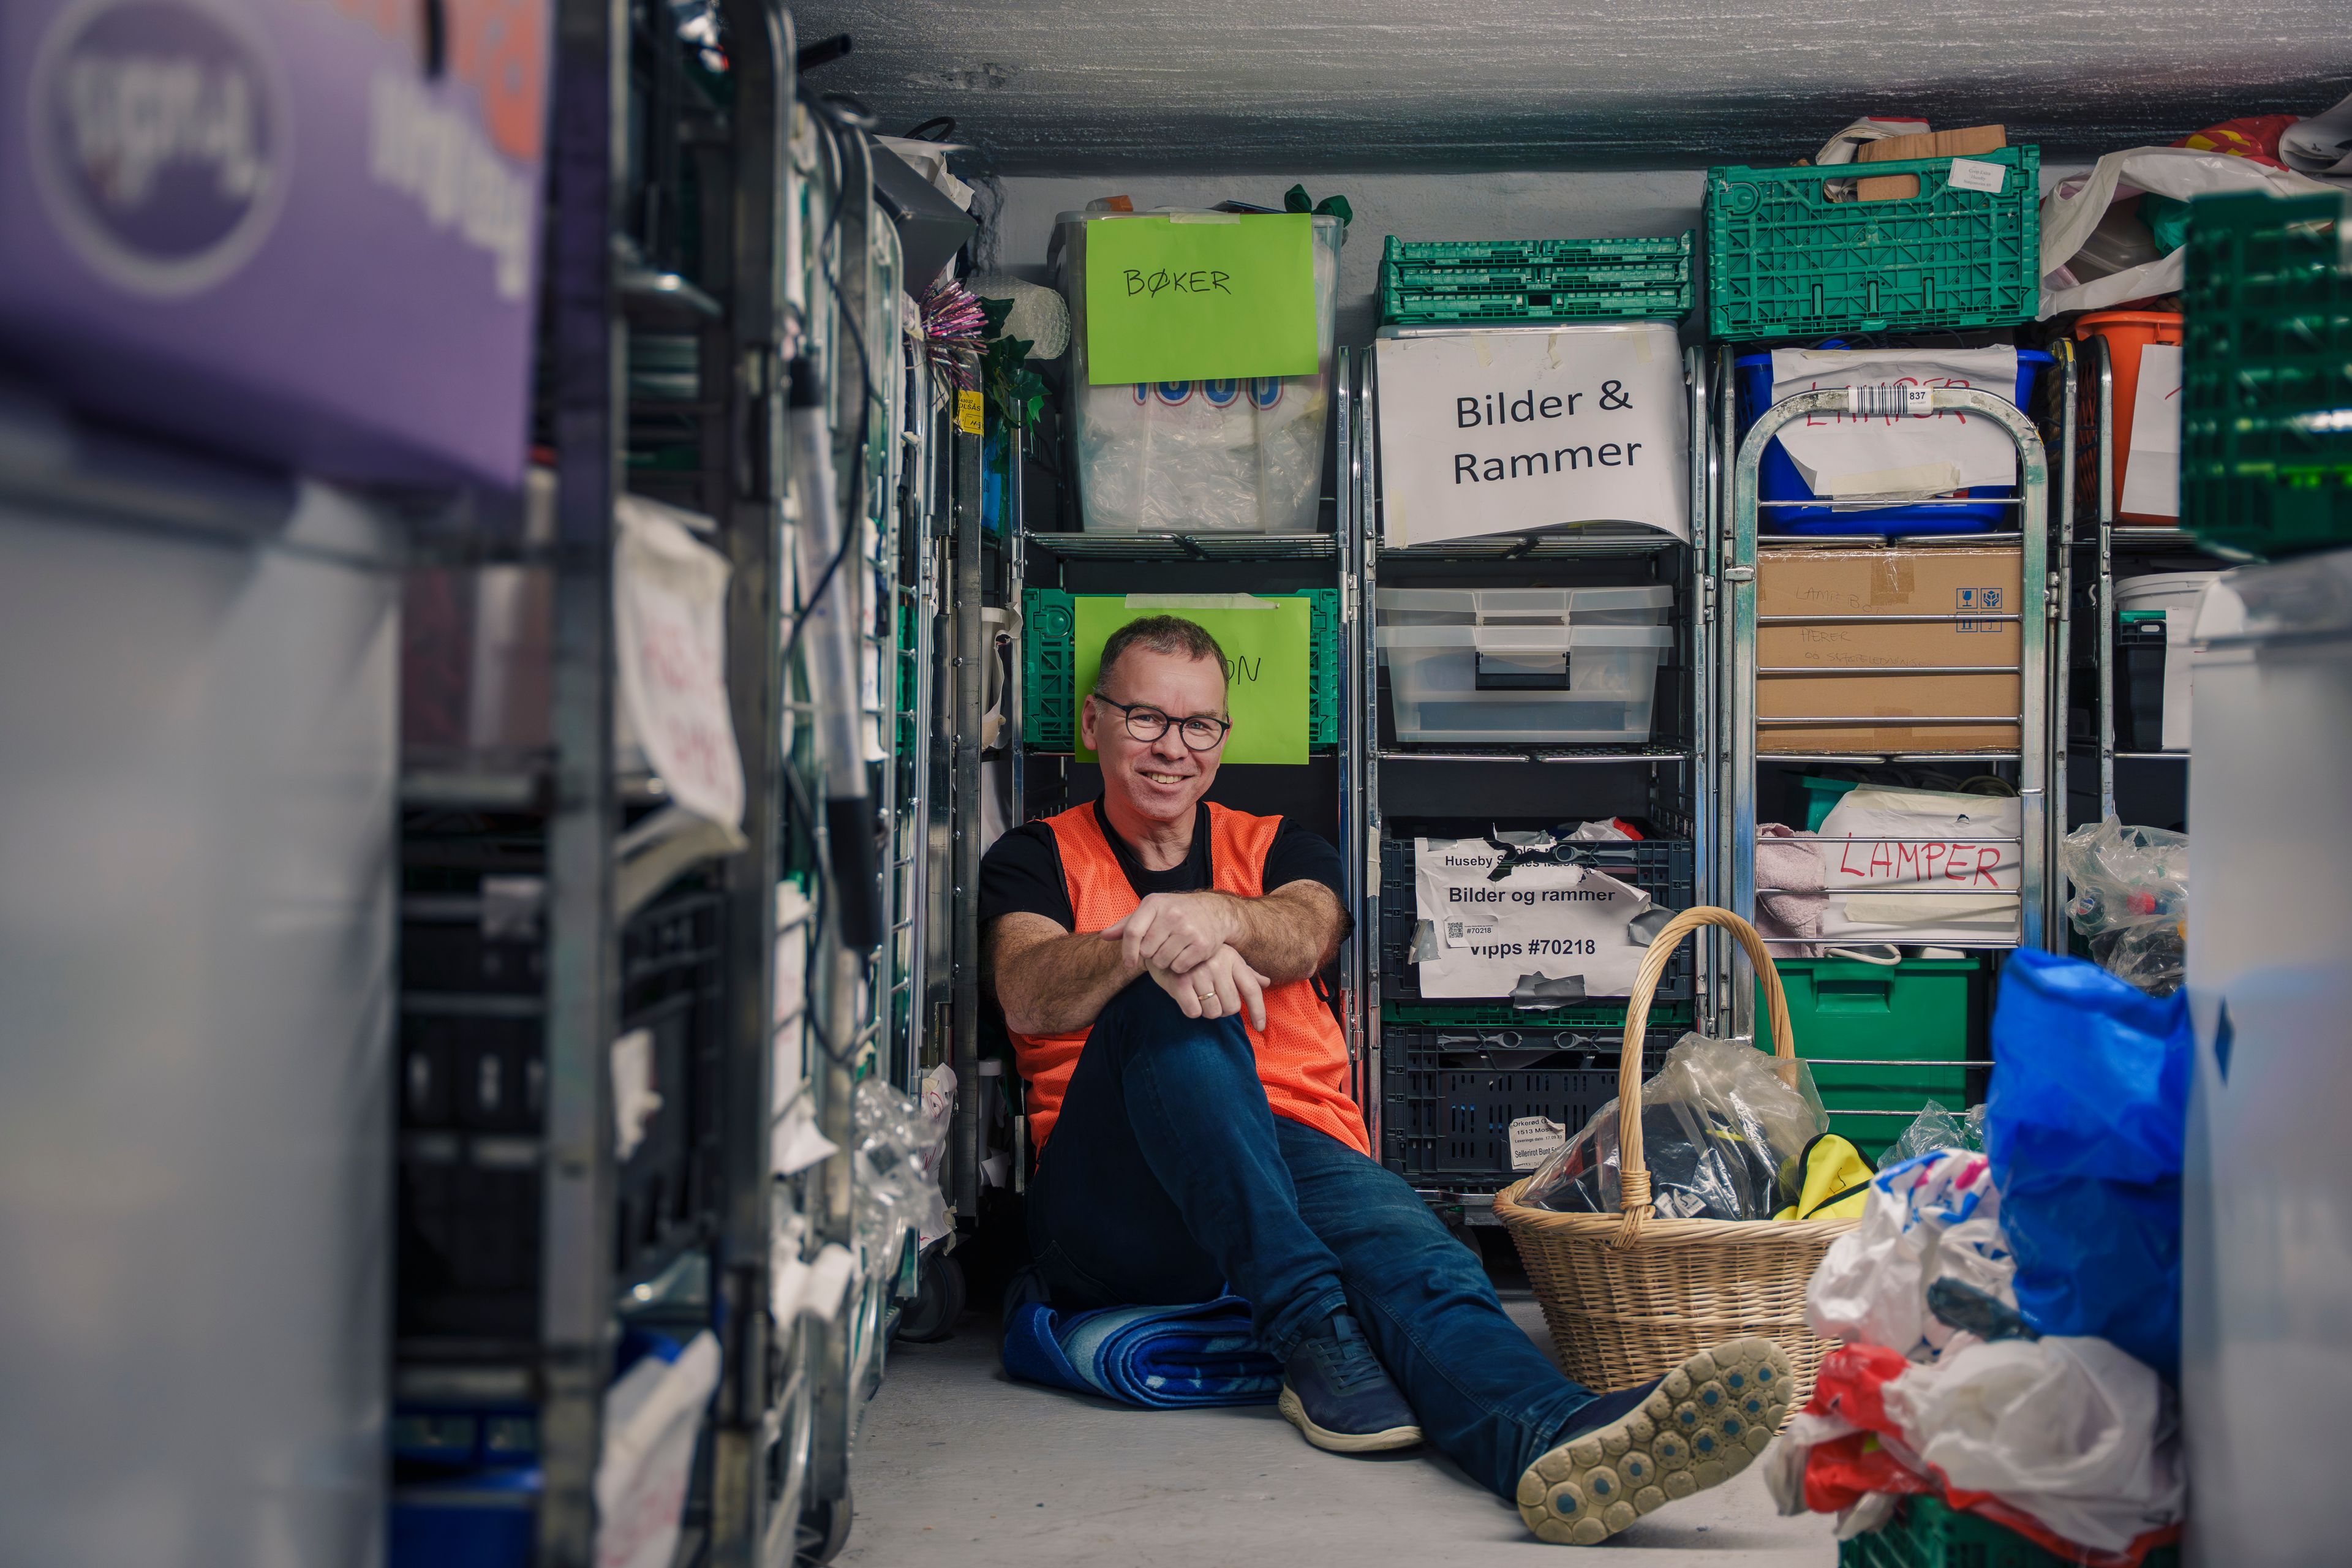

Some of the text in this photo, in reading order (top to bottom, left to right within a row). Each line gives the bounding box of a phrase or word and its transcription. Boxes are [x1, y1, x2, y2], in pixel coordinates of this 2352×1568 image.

[1123, 268, 1232, 298] BØKER
[1457, 379, 1634, 429] Bilder &
[1909, 391, 1926, 400] 837
[1454, 442, 1643, 484] Rammer
[1445, 855, 1493, 868] Huseby
[1840, 832, 2001, 889] LAMPER
[1449, 887, 1616, 906] Bilder og rammer
[1528, 938, 1596, 956] #70218
[1539, 1147, 1551, 1156] Bunt
